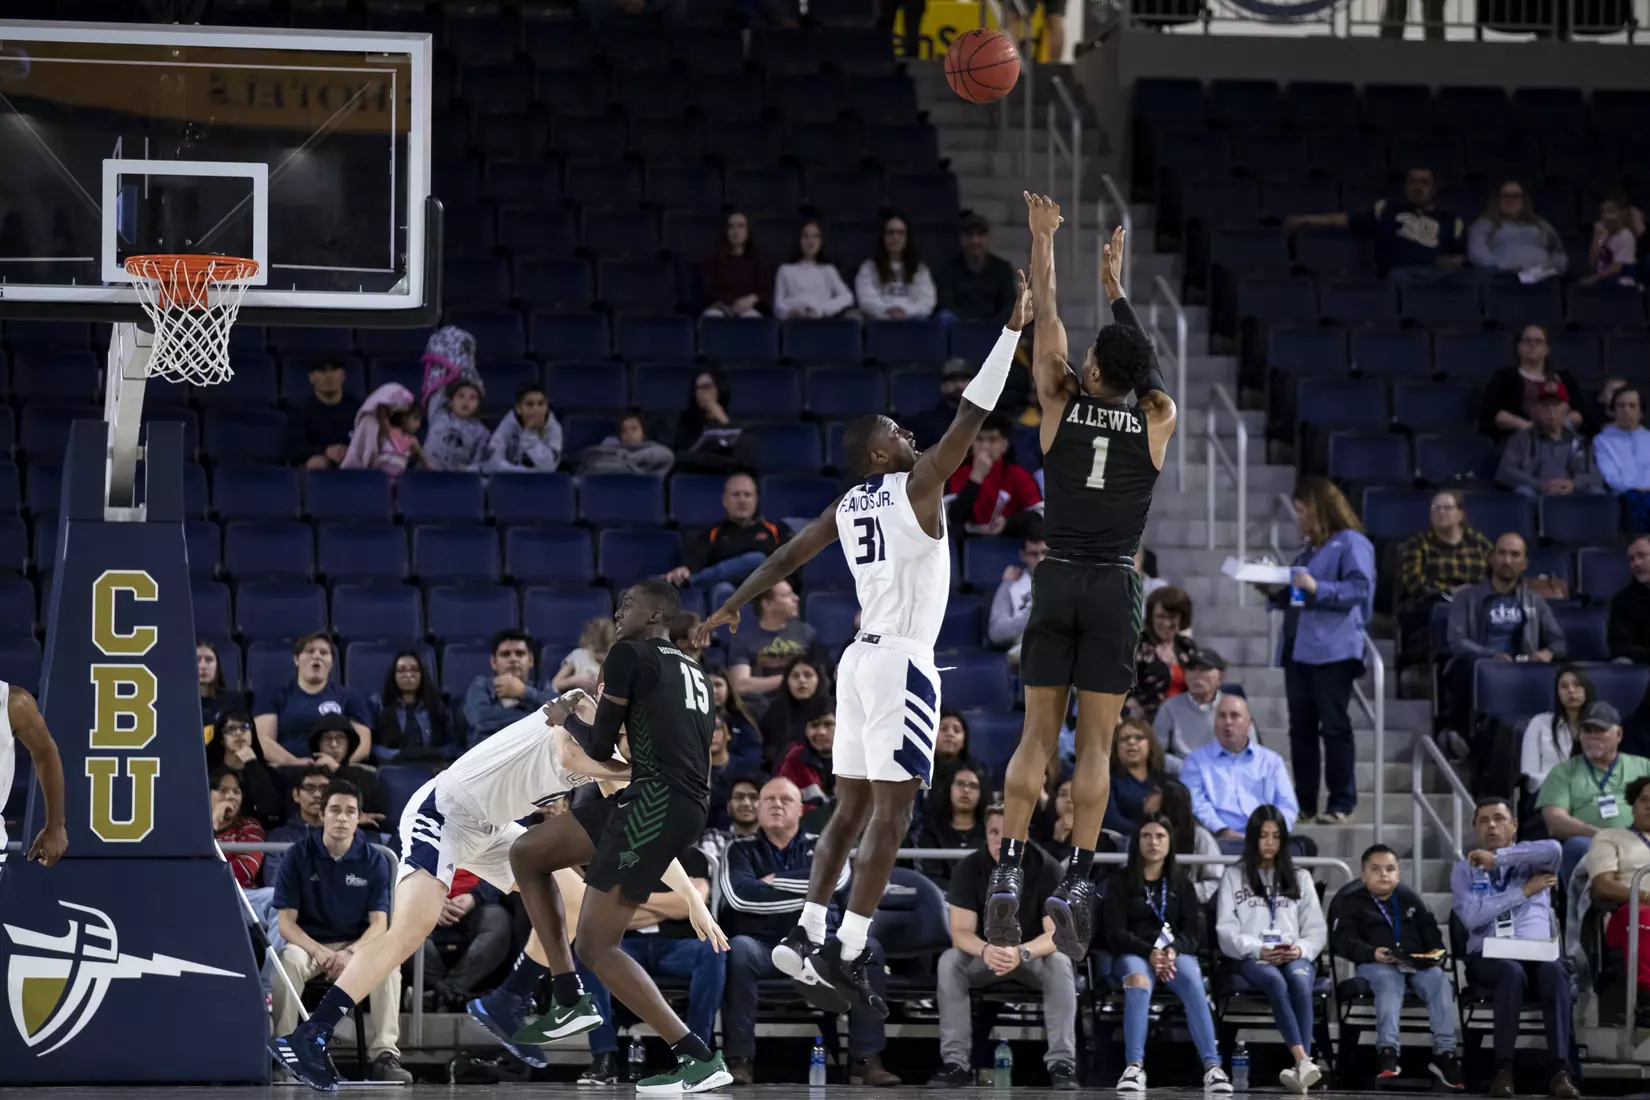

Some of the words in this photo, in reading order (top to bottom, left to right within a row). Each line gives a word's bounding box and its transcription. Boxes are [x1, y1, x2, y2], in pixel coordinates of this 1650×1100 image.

[1066, 403, 1142, 433] A.LEWIS
[1085, 436, 1110, 489] 1
[875, 491, 894, 508] JR.
[853, 515, 886, 565] 31
[85, 569, 160, 843] CBU
[679, 661, 710, 715] 15
